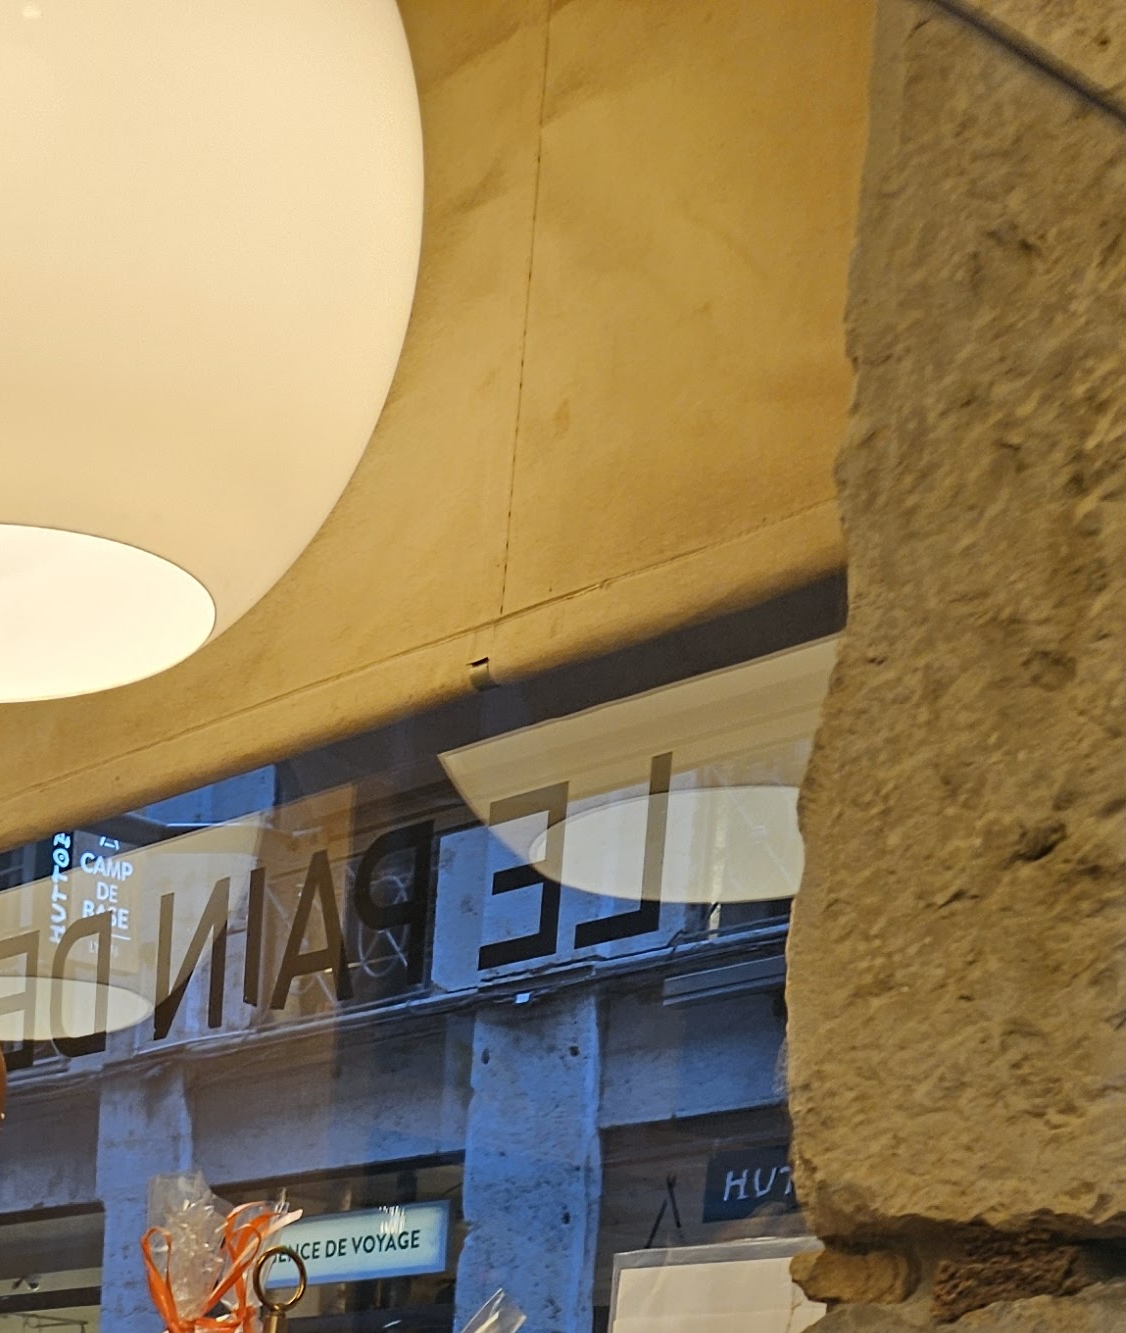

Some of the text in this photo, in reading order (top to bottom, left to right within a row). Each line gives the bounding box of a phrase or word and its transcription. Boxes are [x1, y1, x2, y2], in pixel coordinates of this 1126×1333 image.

[80, 852, 133, 881] CAMP
[97, 881, 118, 903] DE
[325, 1238, 348, 1259] DE
[351, 1229, 421, 1254] VOYAGE
